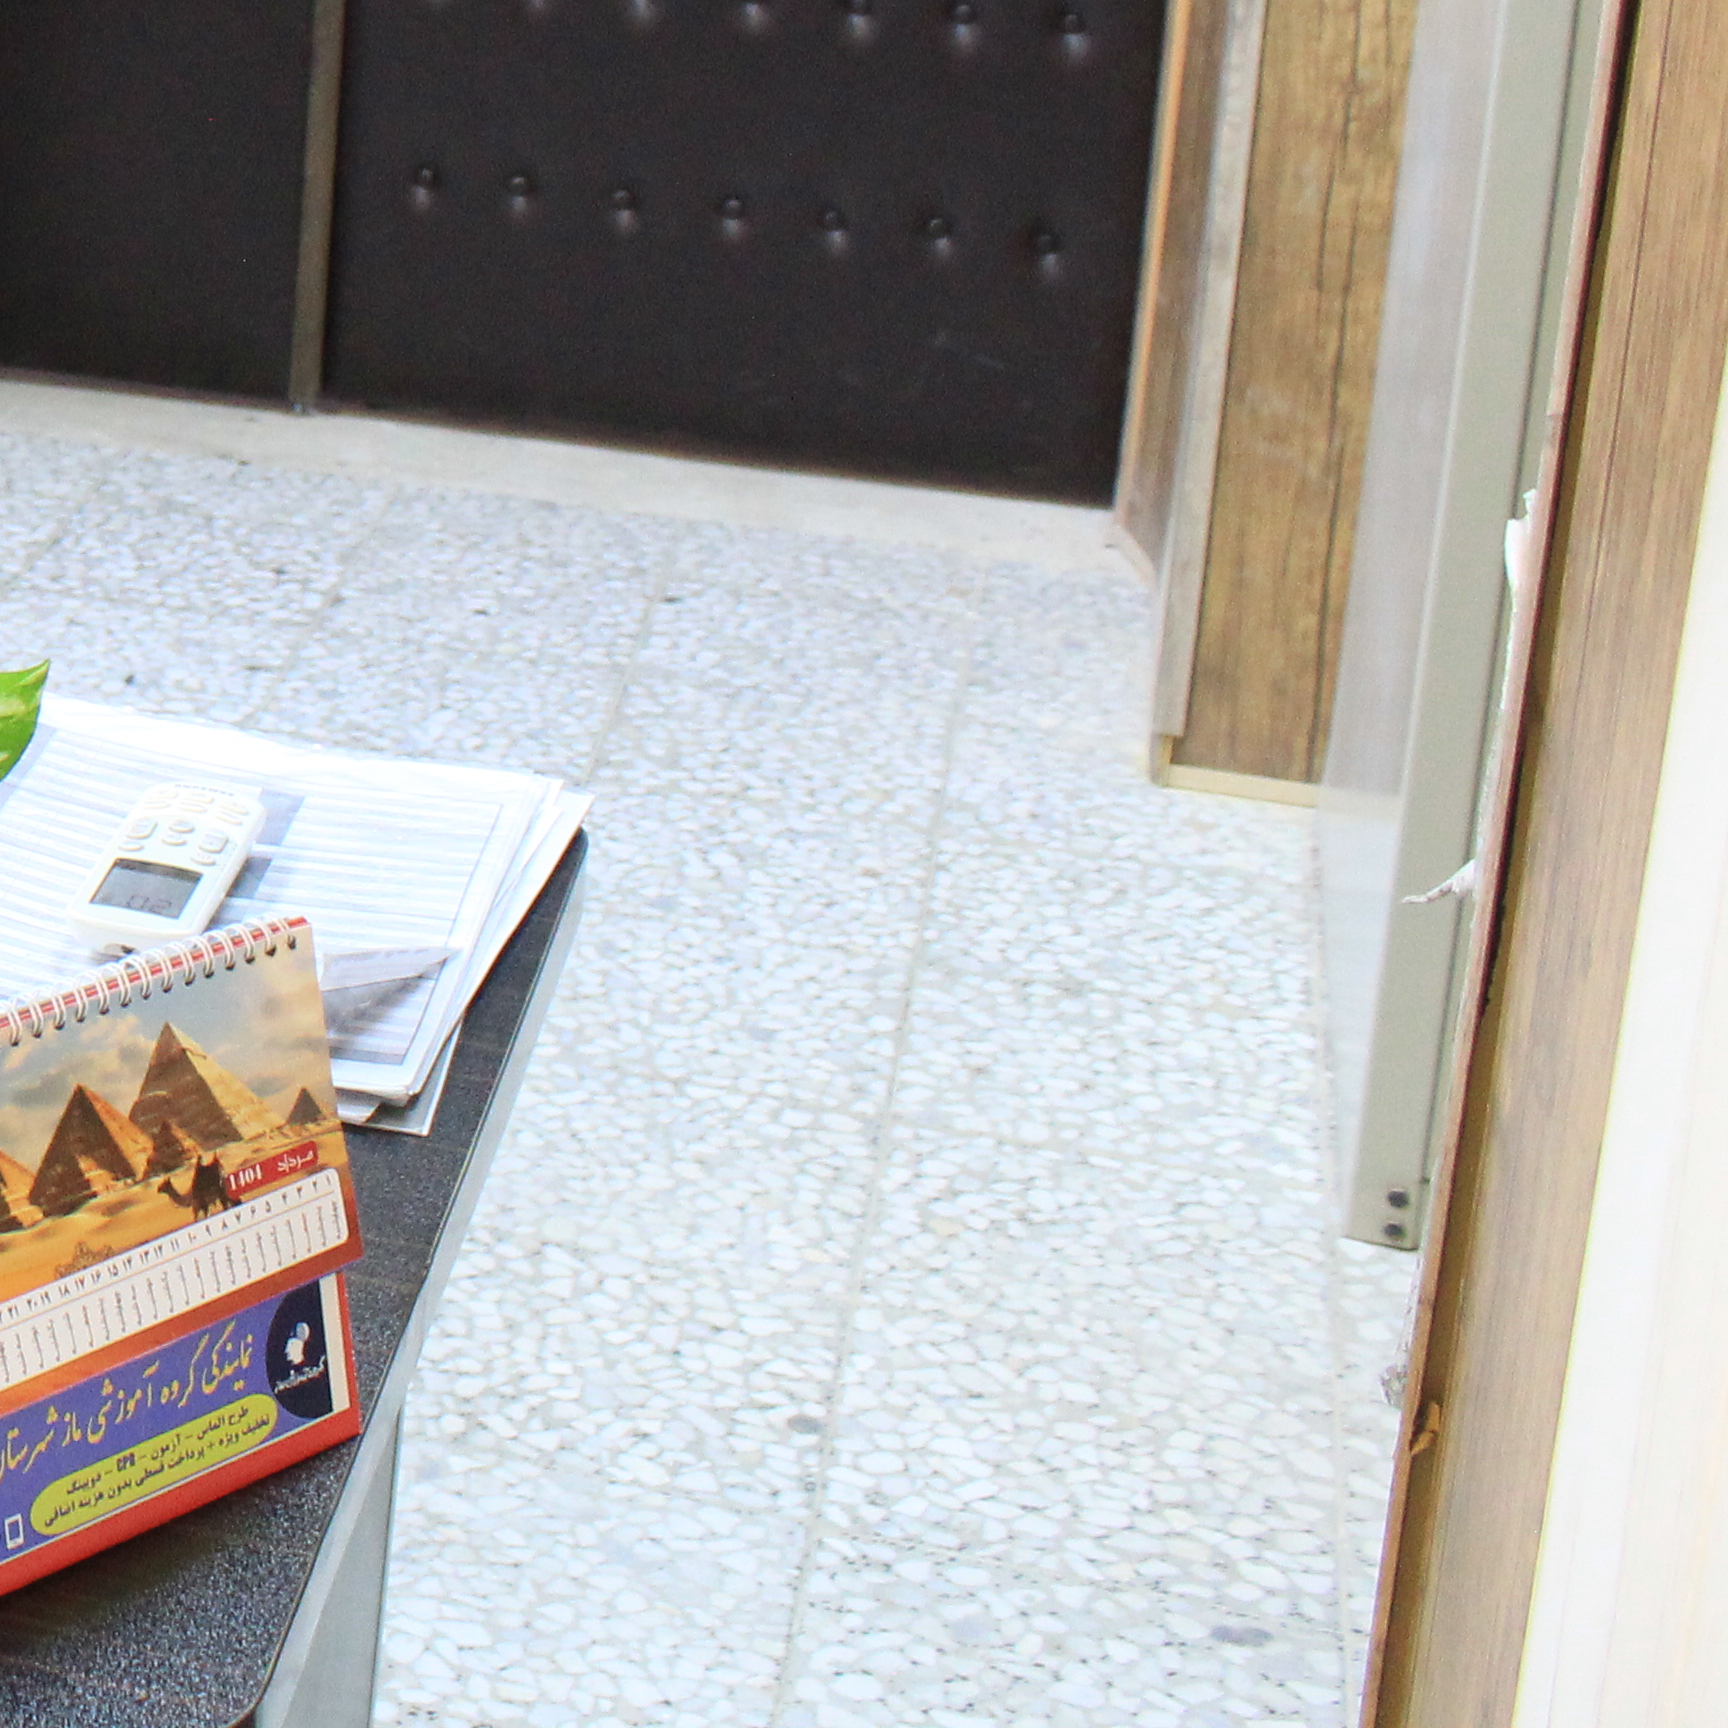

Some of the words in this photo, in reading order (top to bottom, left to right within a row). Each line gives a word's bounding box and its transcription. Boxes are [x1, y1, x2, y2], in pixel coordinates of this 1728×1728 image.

[277, 1150, 315, 1173] مرداد
[159, 1333, 210, 1408] گروه
[201, 1318, 254, 1394] نمایندگی
[87, 1359, 160, 1444] آموزشی
[227, 1405, 249, 1425] طرح
[61, 1411, 82, 1448] ماز
[150, 1433, 182, 1462] آزمون
